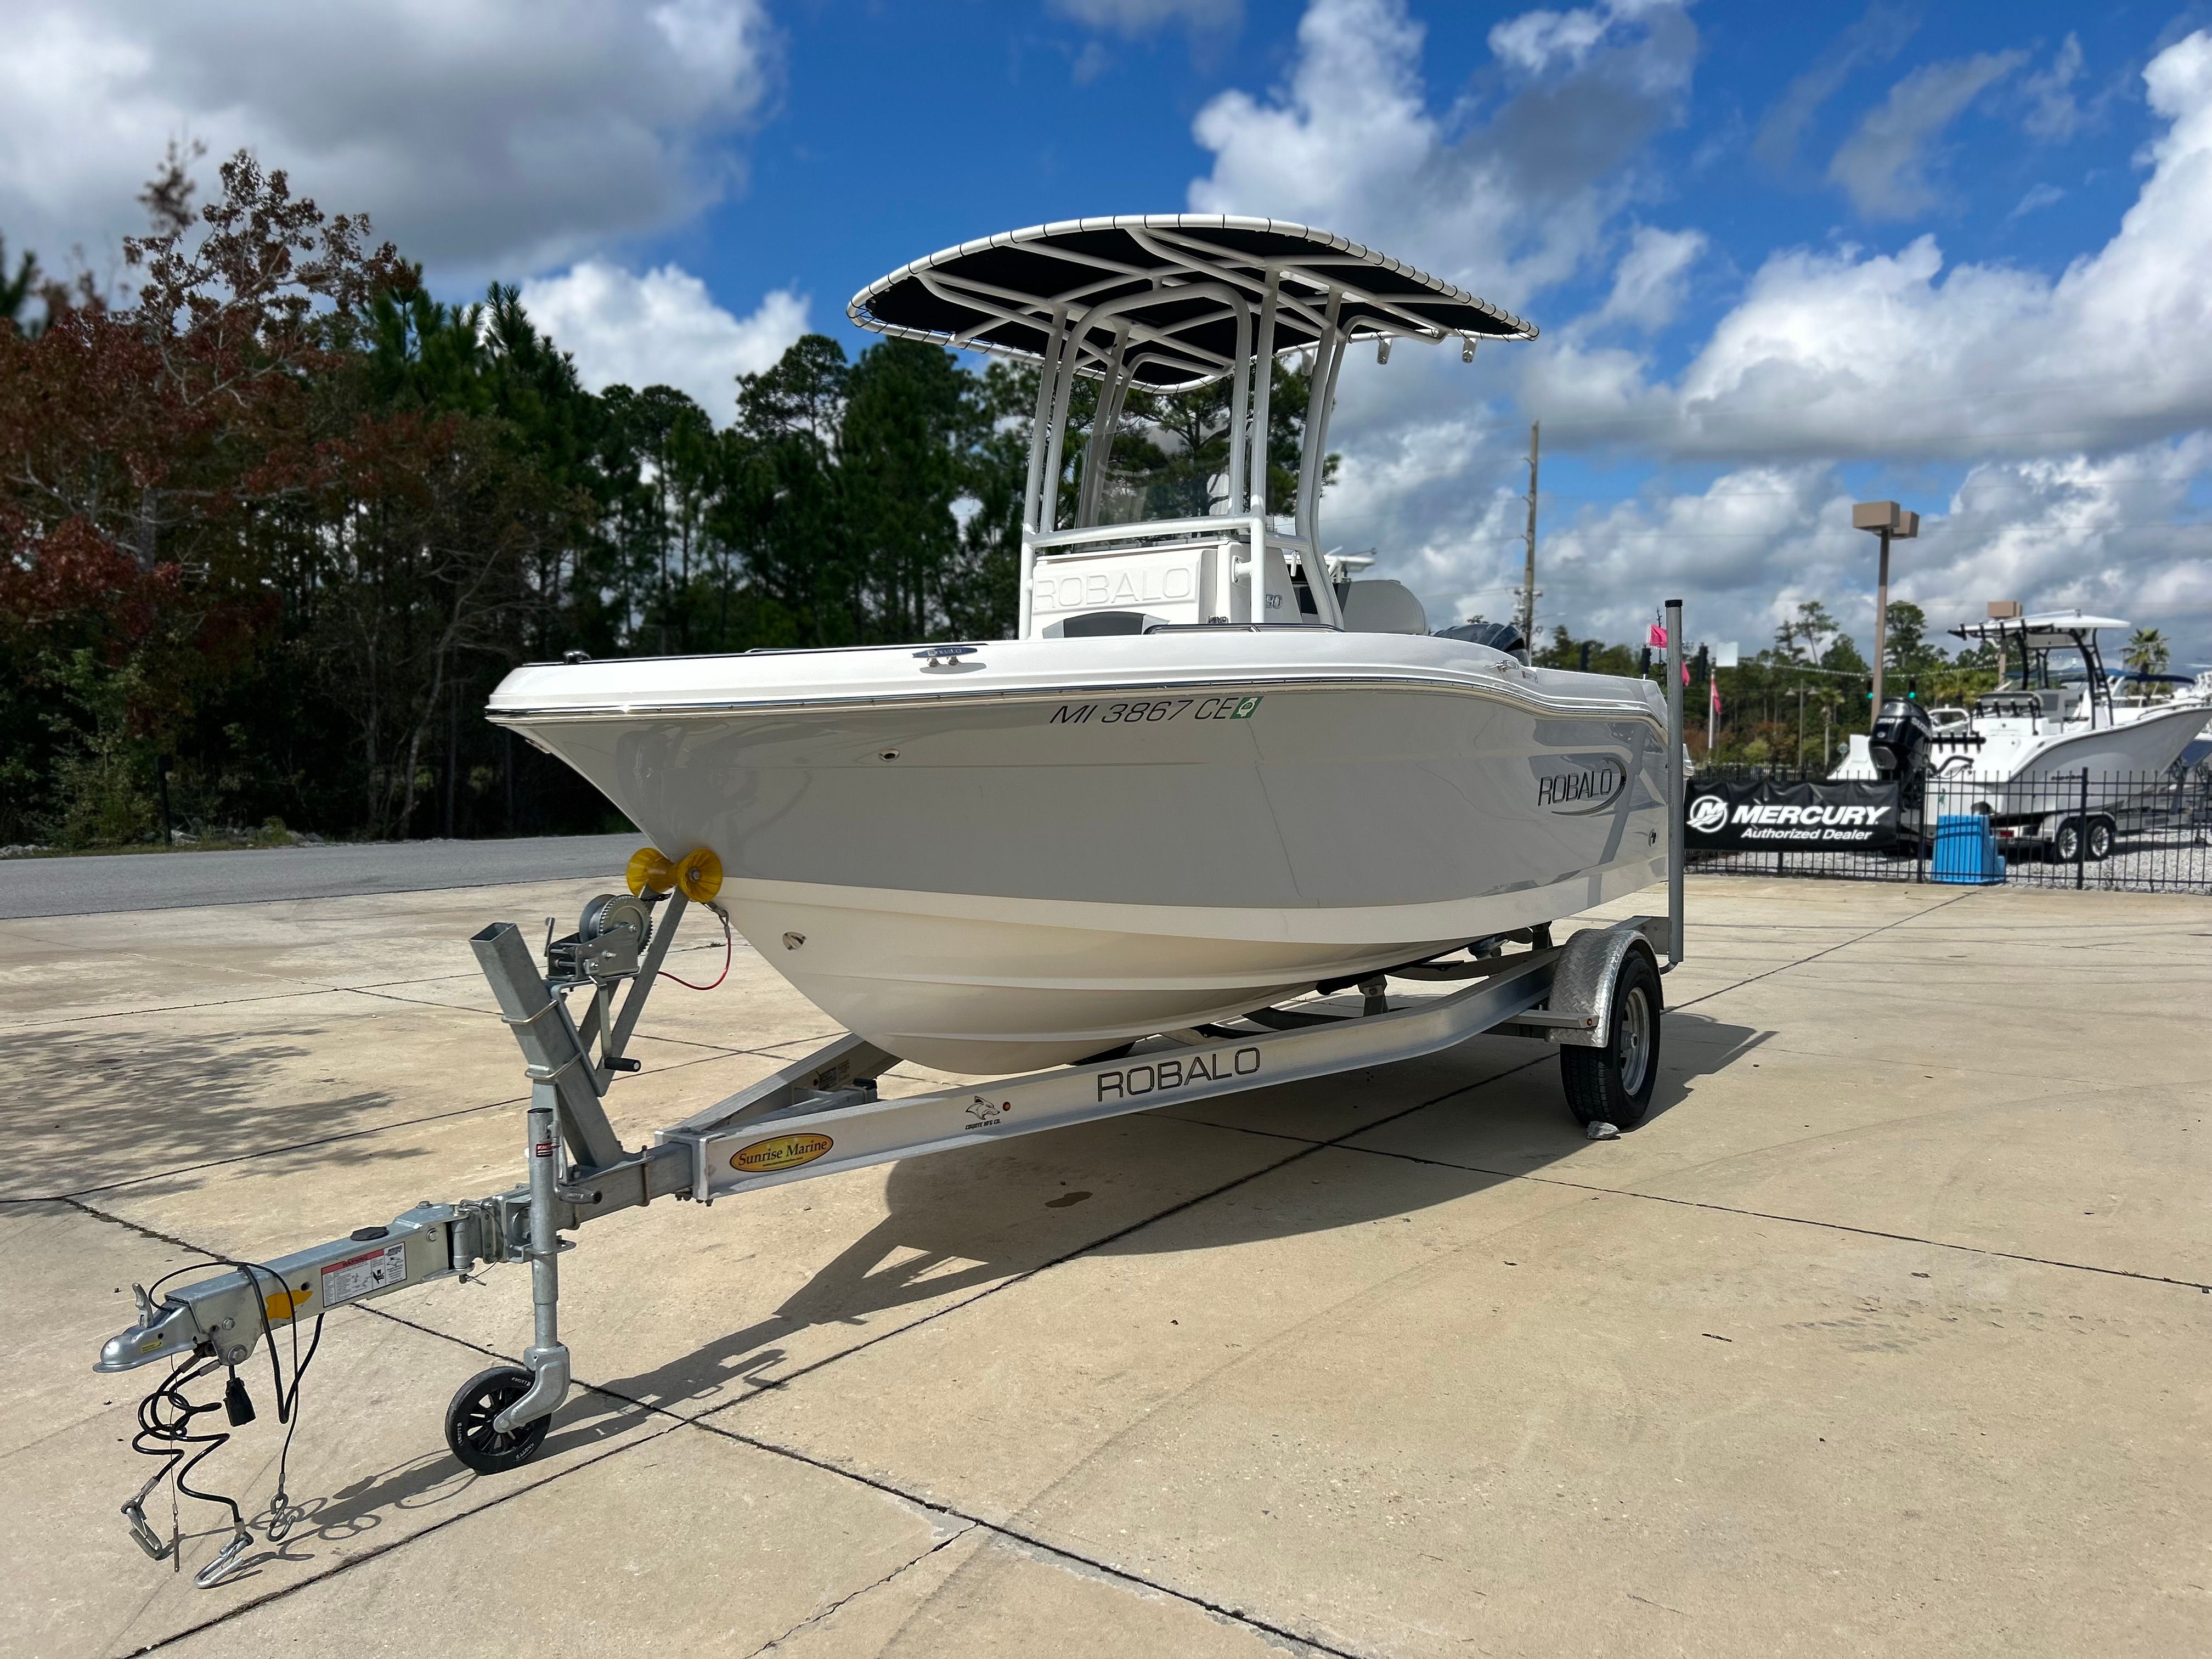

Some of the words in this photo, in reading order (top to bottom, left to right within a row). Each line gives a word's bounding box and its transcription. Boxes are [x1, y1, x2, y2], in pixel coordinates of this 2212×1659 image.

[1035, 568, 1191, 610] ROBALO
[1049, 705, 1098, 724] MI
[1102, 699, 1194, 723] 3867
[1194, 697, 1239, 720] CE
[1911, 717, 1932, 738] SUZU
[1538, 769, 1612, 806] ROBALO
[1731, 805, 1891, 825] MERCURY
[1741, 828, 1819, 839] Authorized
[1822, 828, 1872, 840] Dealer
[1098, 1047, 1260, 1102] ROBALO
[738, 1148, 782, 1166] Sunrise
[786, 1140, 827, 1157] Marine
[342, 1255, 368, 1267] WARNING
